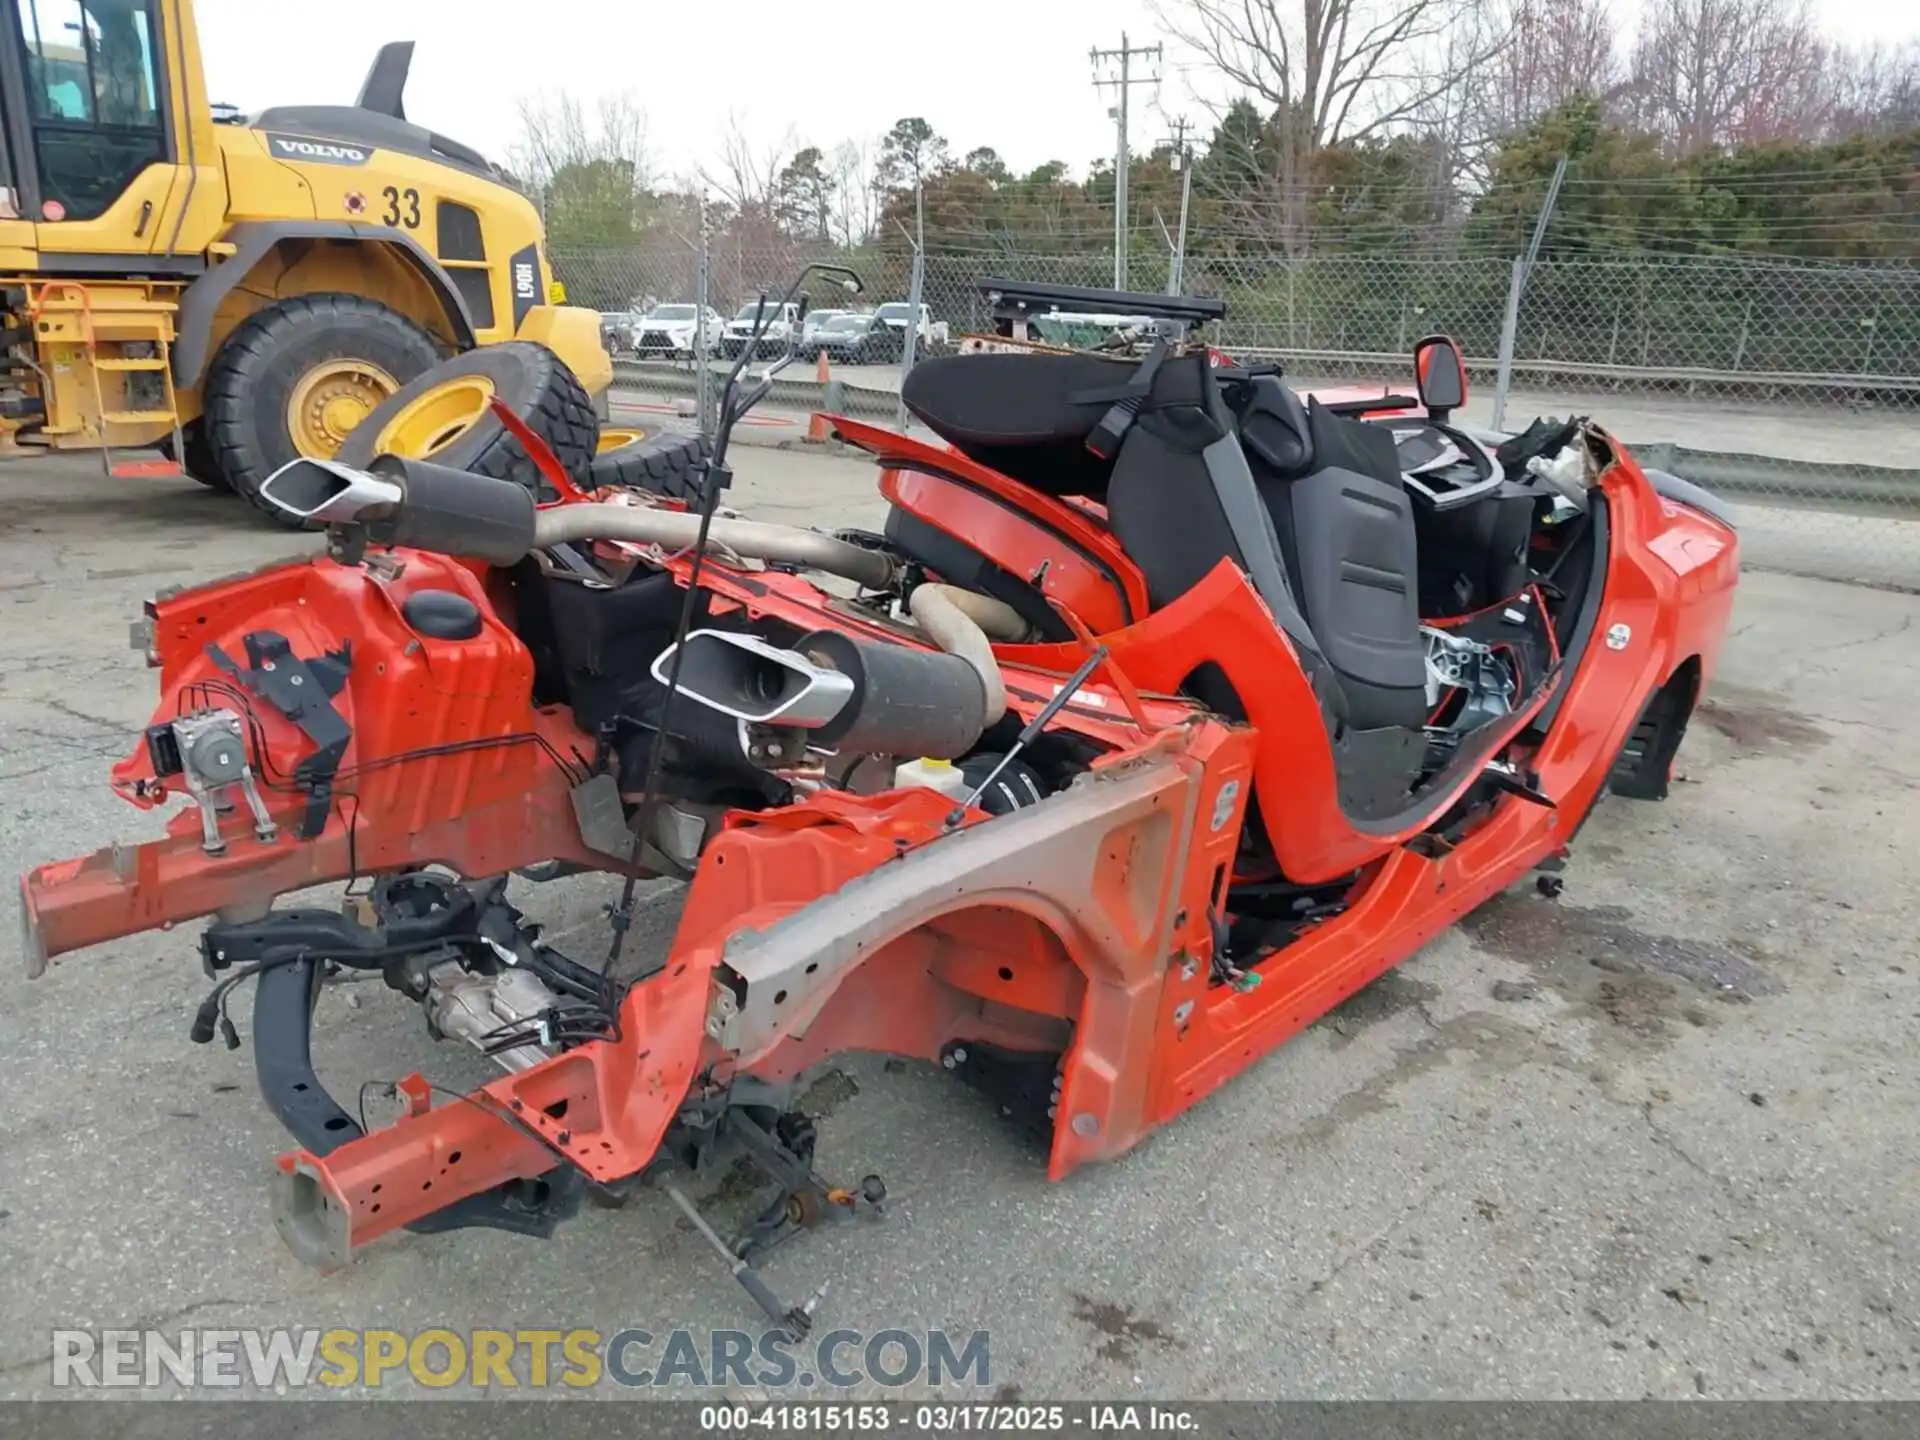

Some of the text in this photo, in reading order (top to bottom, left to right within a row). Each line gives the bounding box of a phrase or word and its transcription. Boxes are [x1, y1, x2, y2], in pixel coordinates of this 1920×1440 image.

[275, 139, 366, 162] VOLVO
[382, 185, 421, 230] 33
[515, 263, 535, 299] L90H
